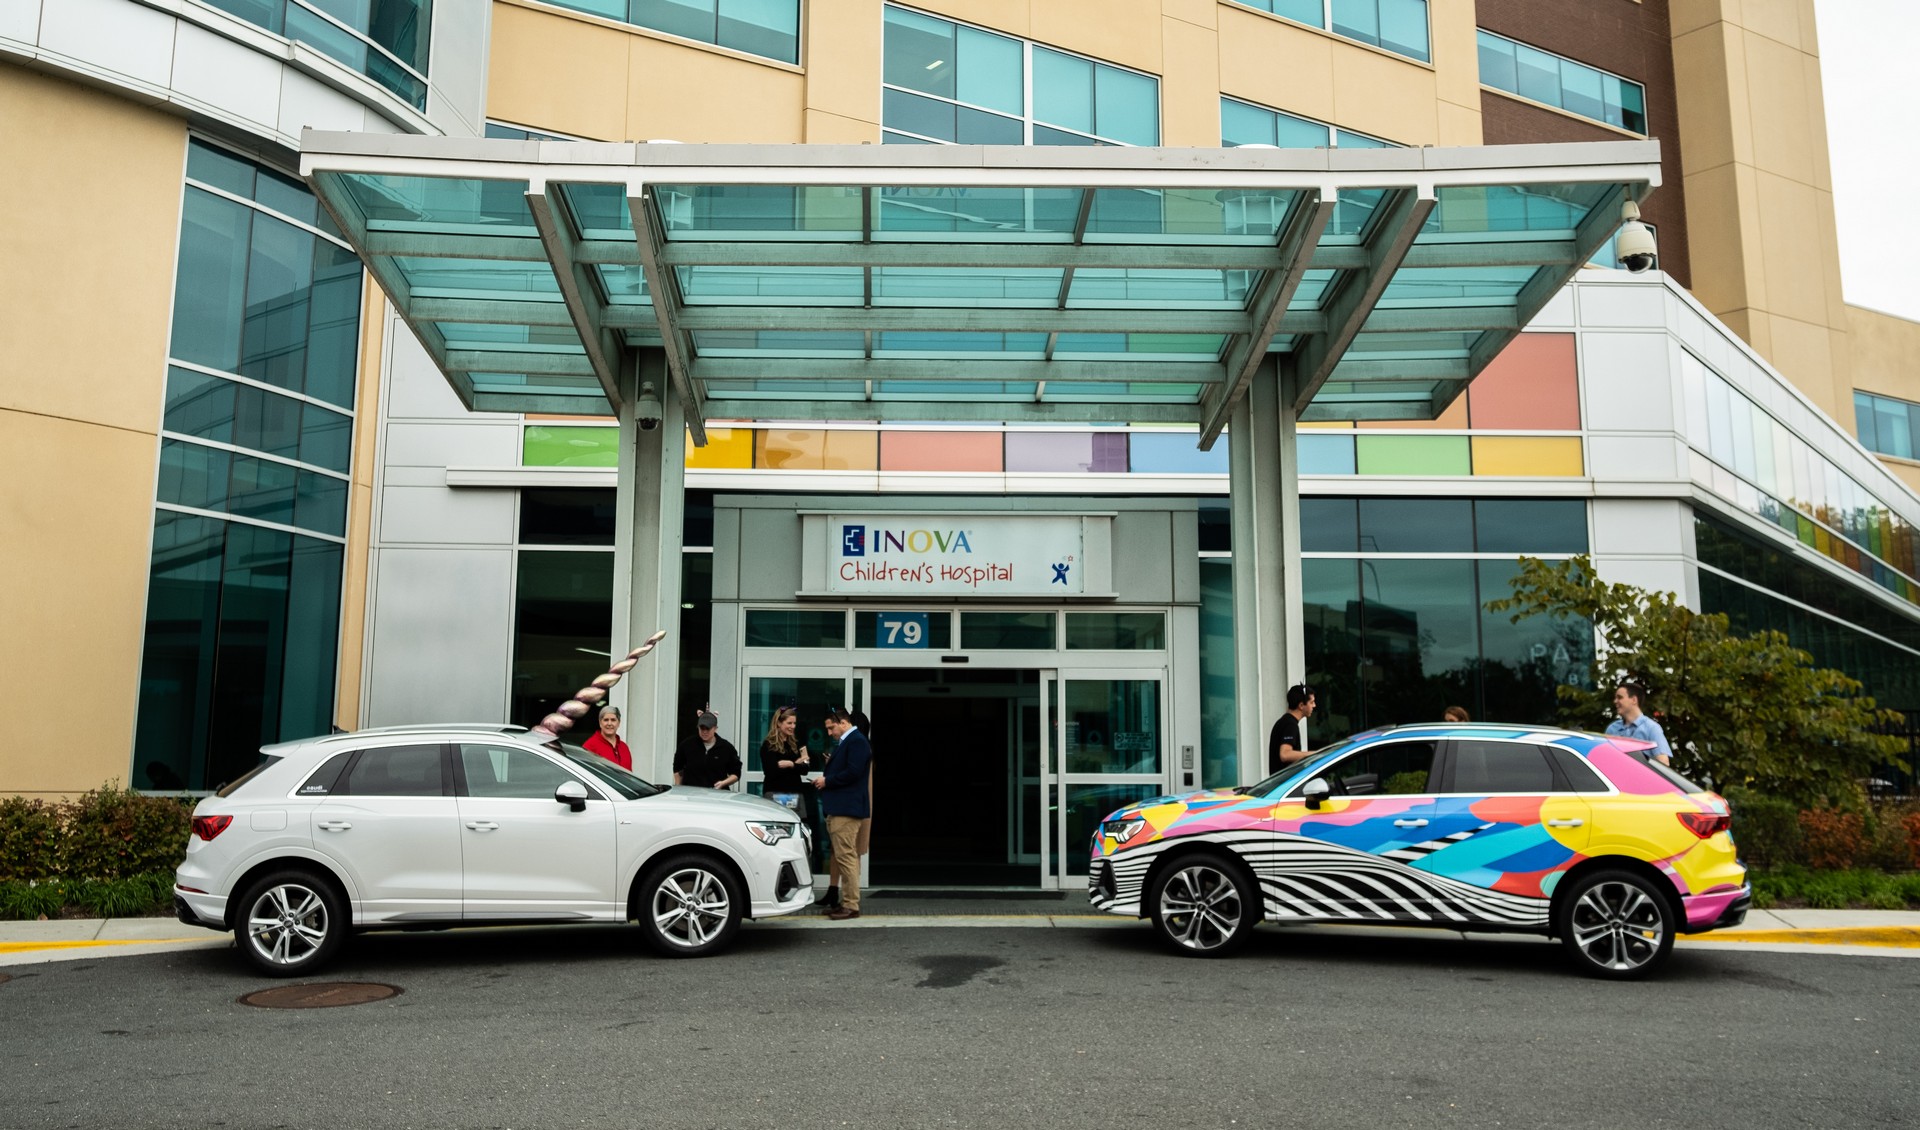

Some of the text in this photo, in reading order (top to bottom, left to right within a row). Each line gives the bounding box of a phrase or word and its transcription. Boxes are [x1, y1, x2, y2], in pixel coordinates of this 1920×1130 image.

[874, 530, 972, 553] INOVA
[840, 561, 1013, 588] Children's Hospital
[883, 621, 922, 645] 79
